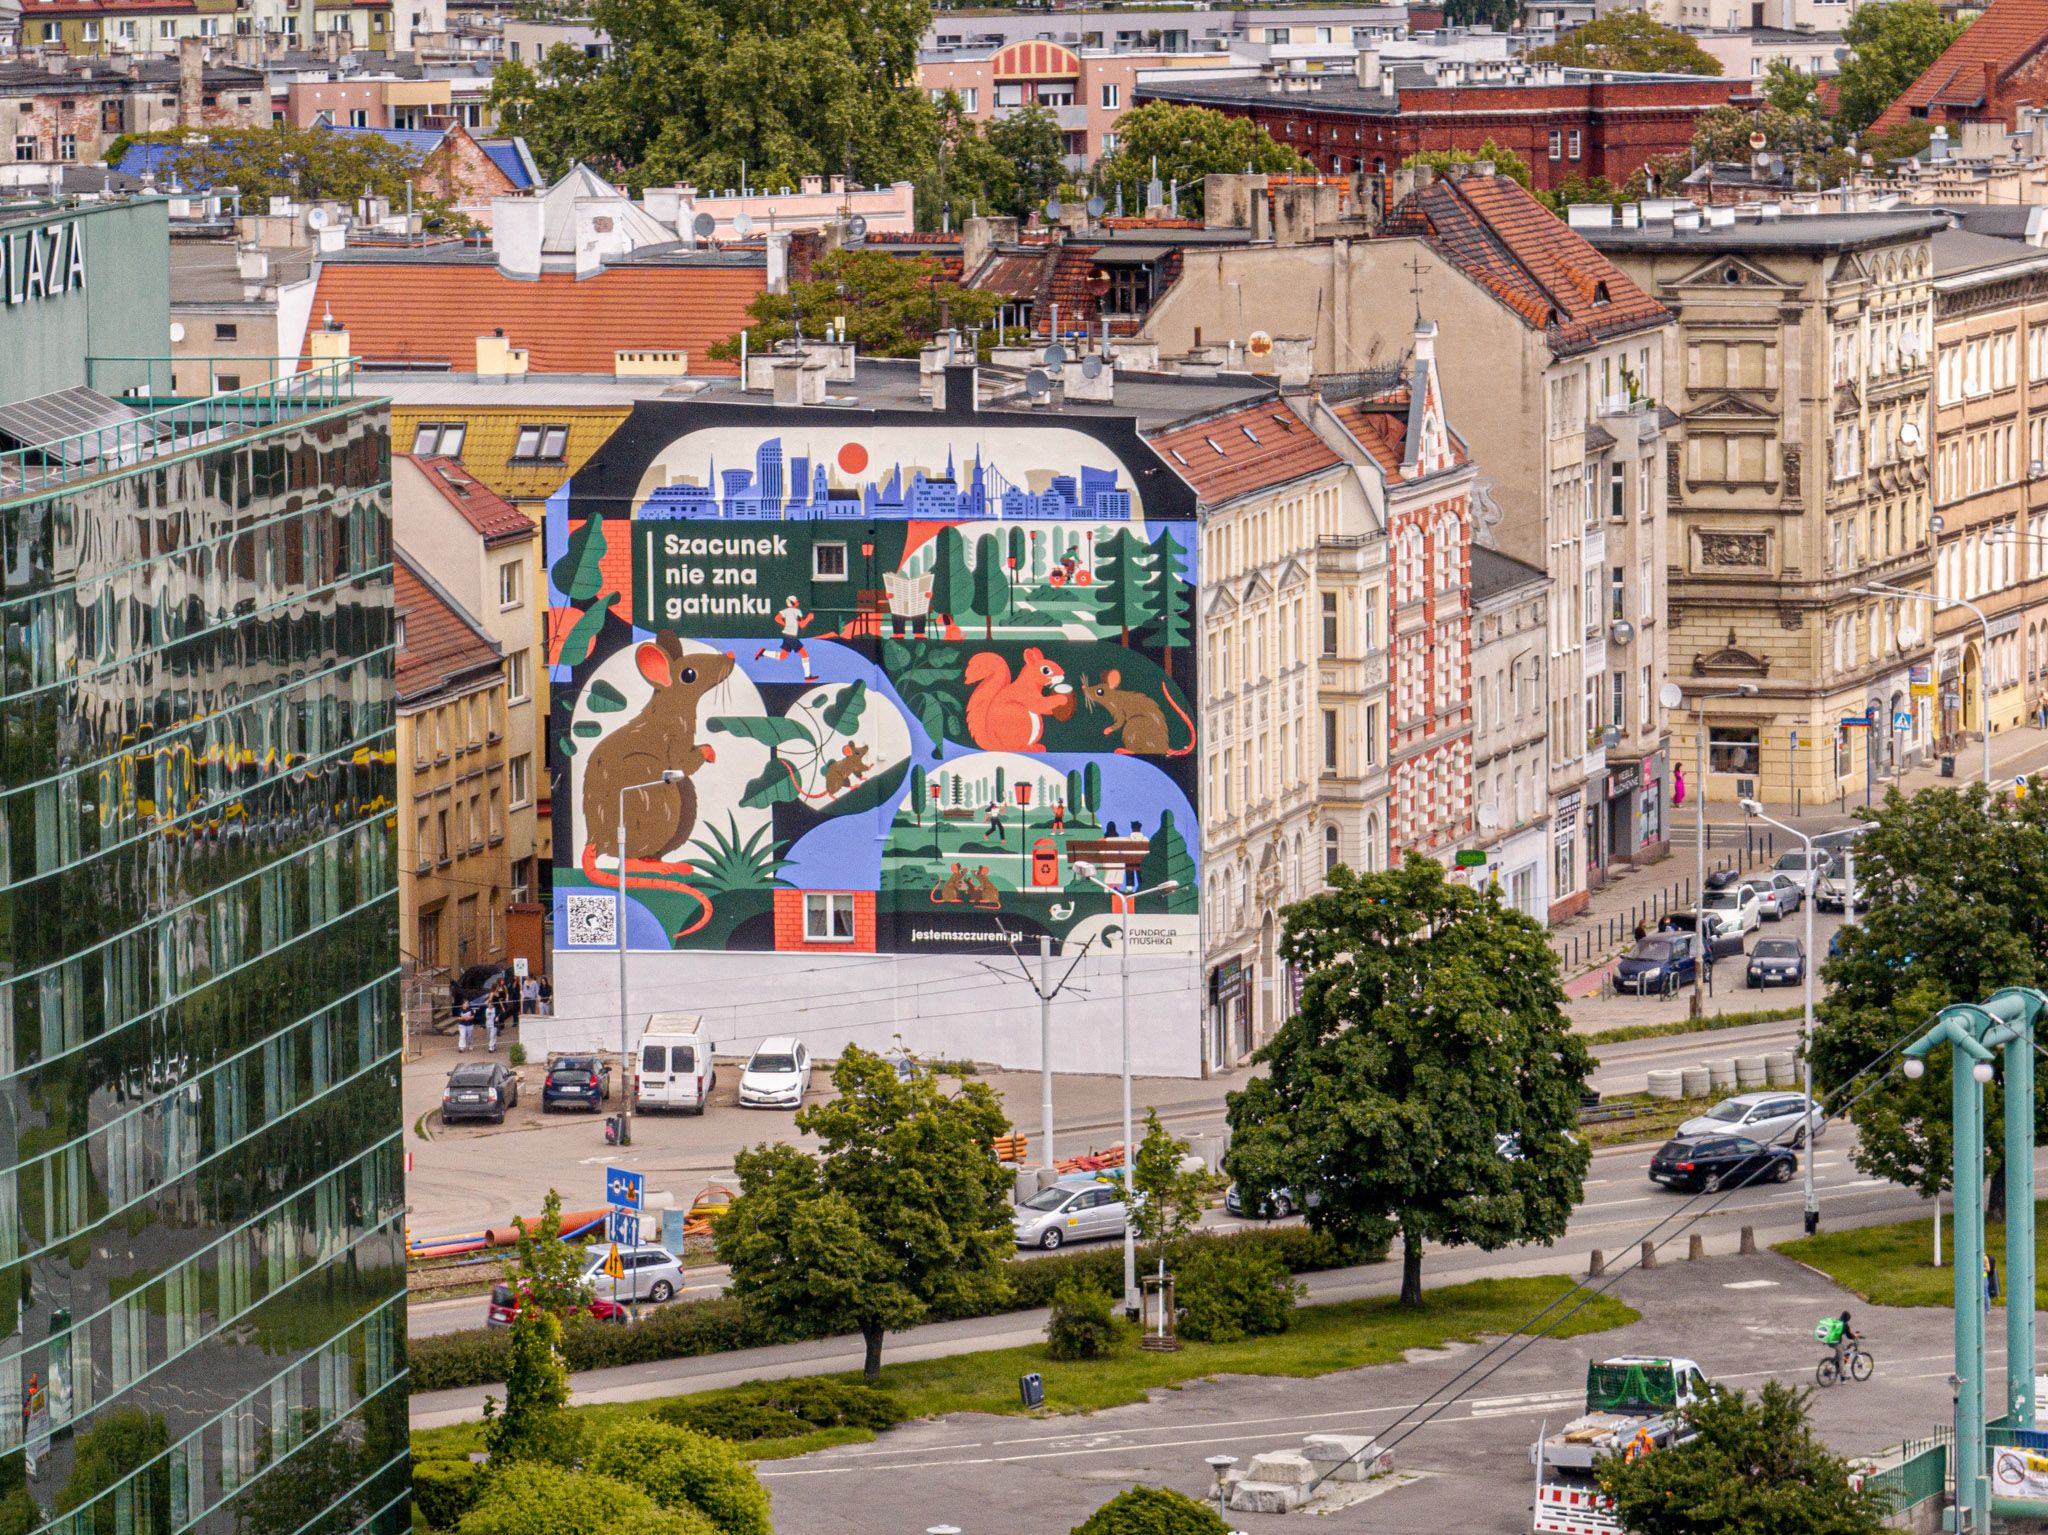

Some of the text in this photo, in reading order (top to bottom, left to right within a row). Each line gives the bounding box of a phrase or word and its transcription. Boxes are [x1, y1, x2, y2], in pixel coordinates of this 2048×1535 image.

[0, 221, 86, 303] LAZA
[664, 534, 788, 556] Szacunek
[665, 563, 757, 585] nie zna
[665, 593, 771, 619] gatunku
[911, 929, 1023, 943] jestemszczurempl
[1129, 928, 1177, 937] FUNDACJA
[1129, 937, 1173, 946] MUSHIKA
